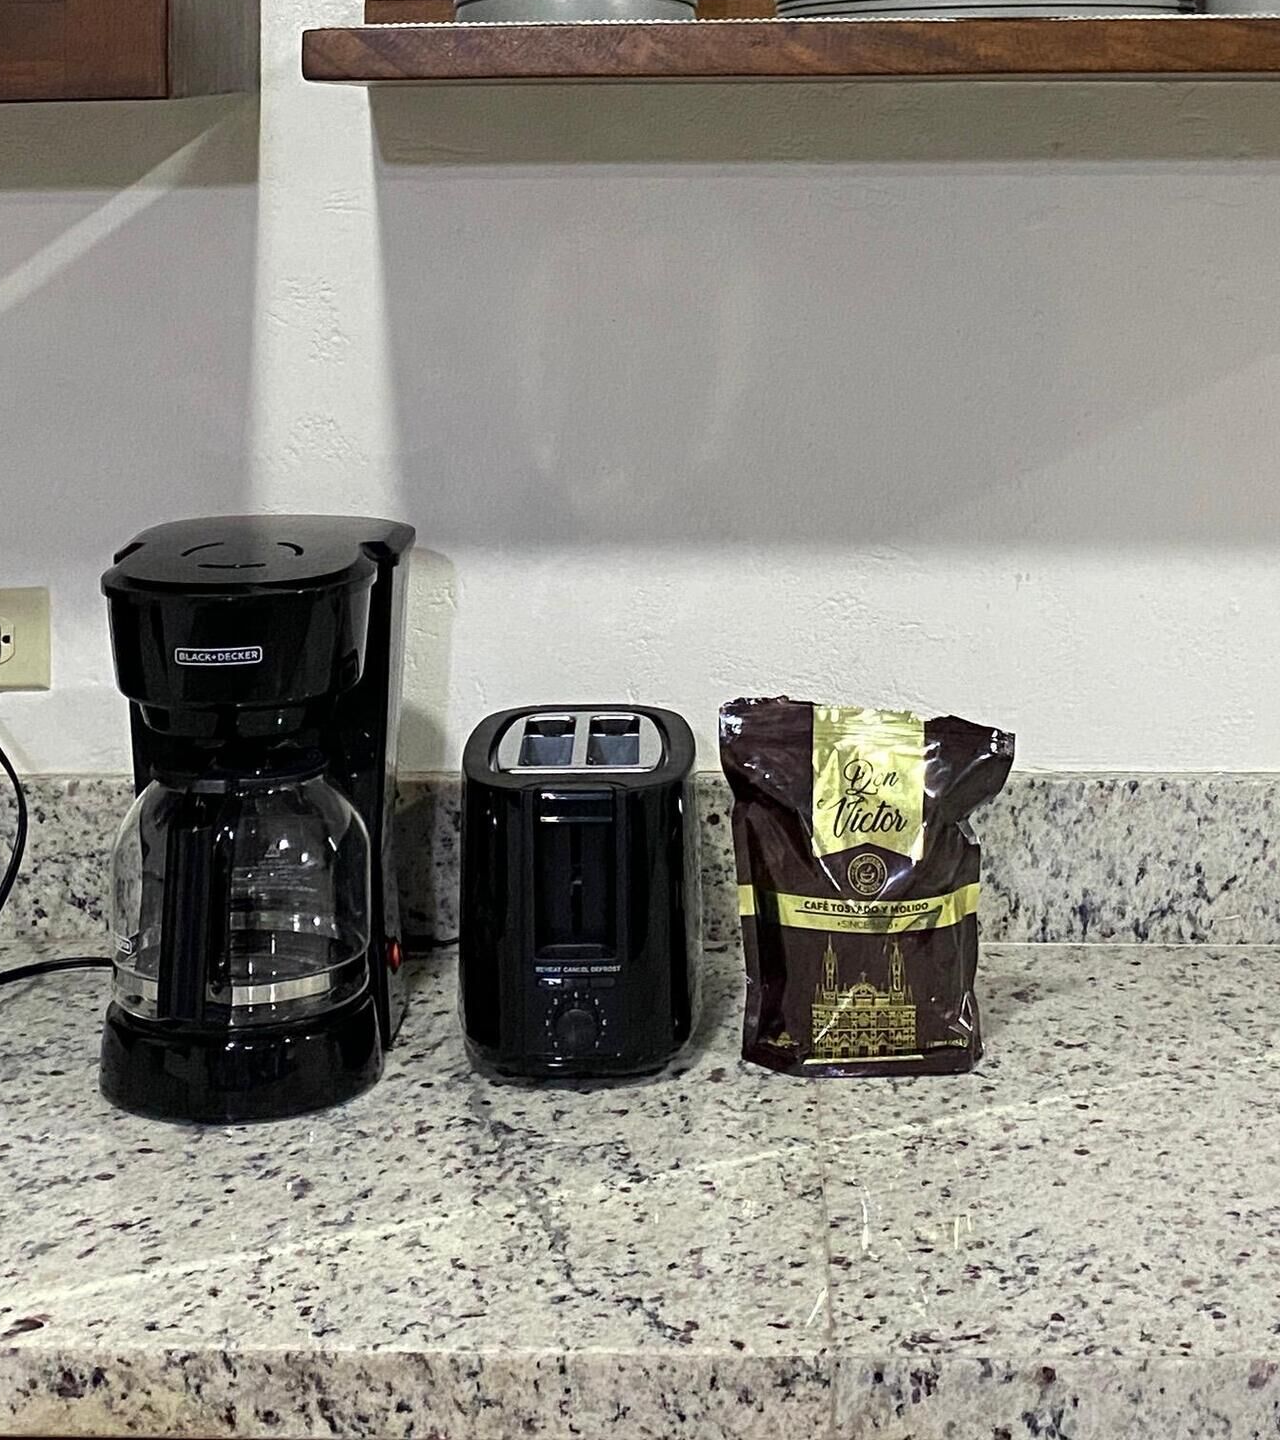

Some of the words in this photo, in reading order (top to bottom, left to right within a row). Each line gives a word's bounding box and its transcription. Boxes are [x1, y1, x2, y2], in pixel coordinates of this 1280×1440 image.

[178, 650, 259, 662] BLACK+DECKER
[816, 794, 908, 838] Victor
[803, 900, 829, 912] CAFÉ
[881, 905, 889, 914] Y
[890, 901, 929, 914] MOLIDO
